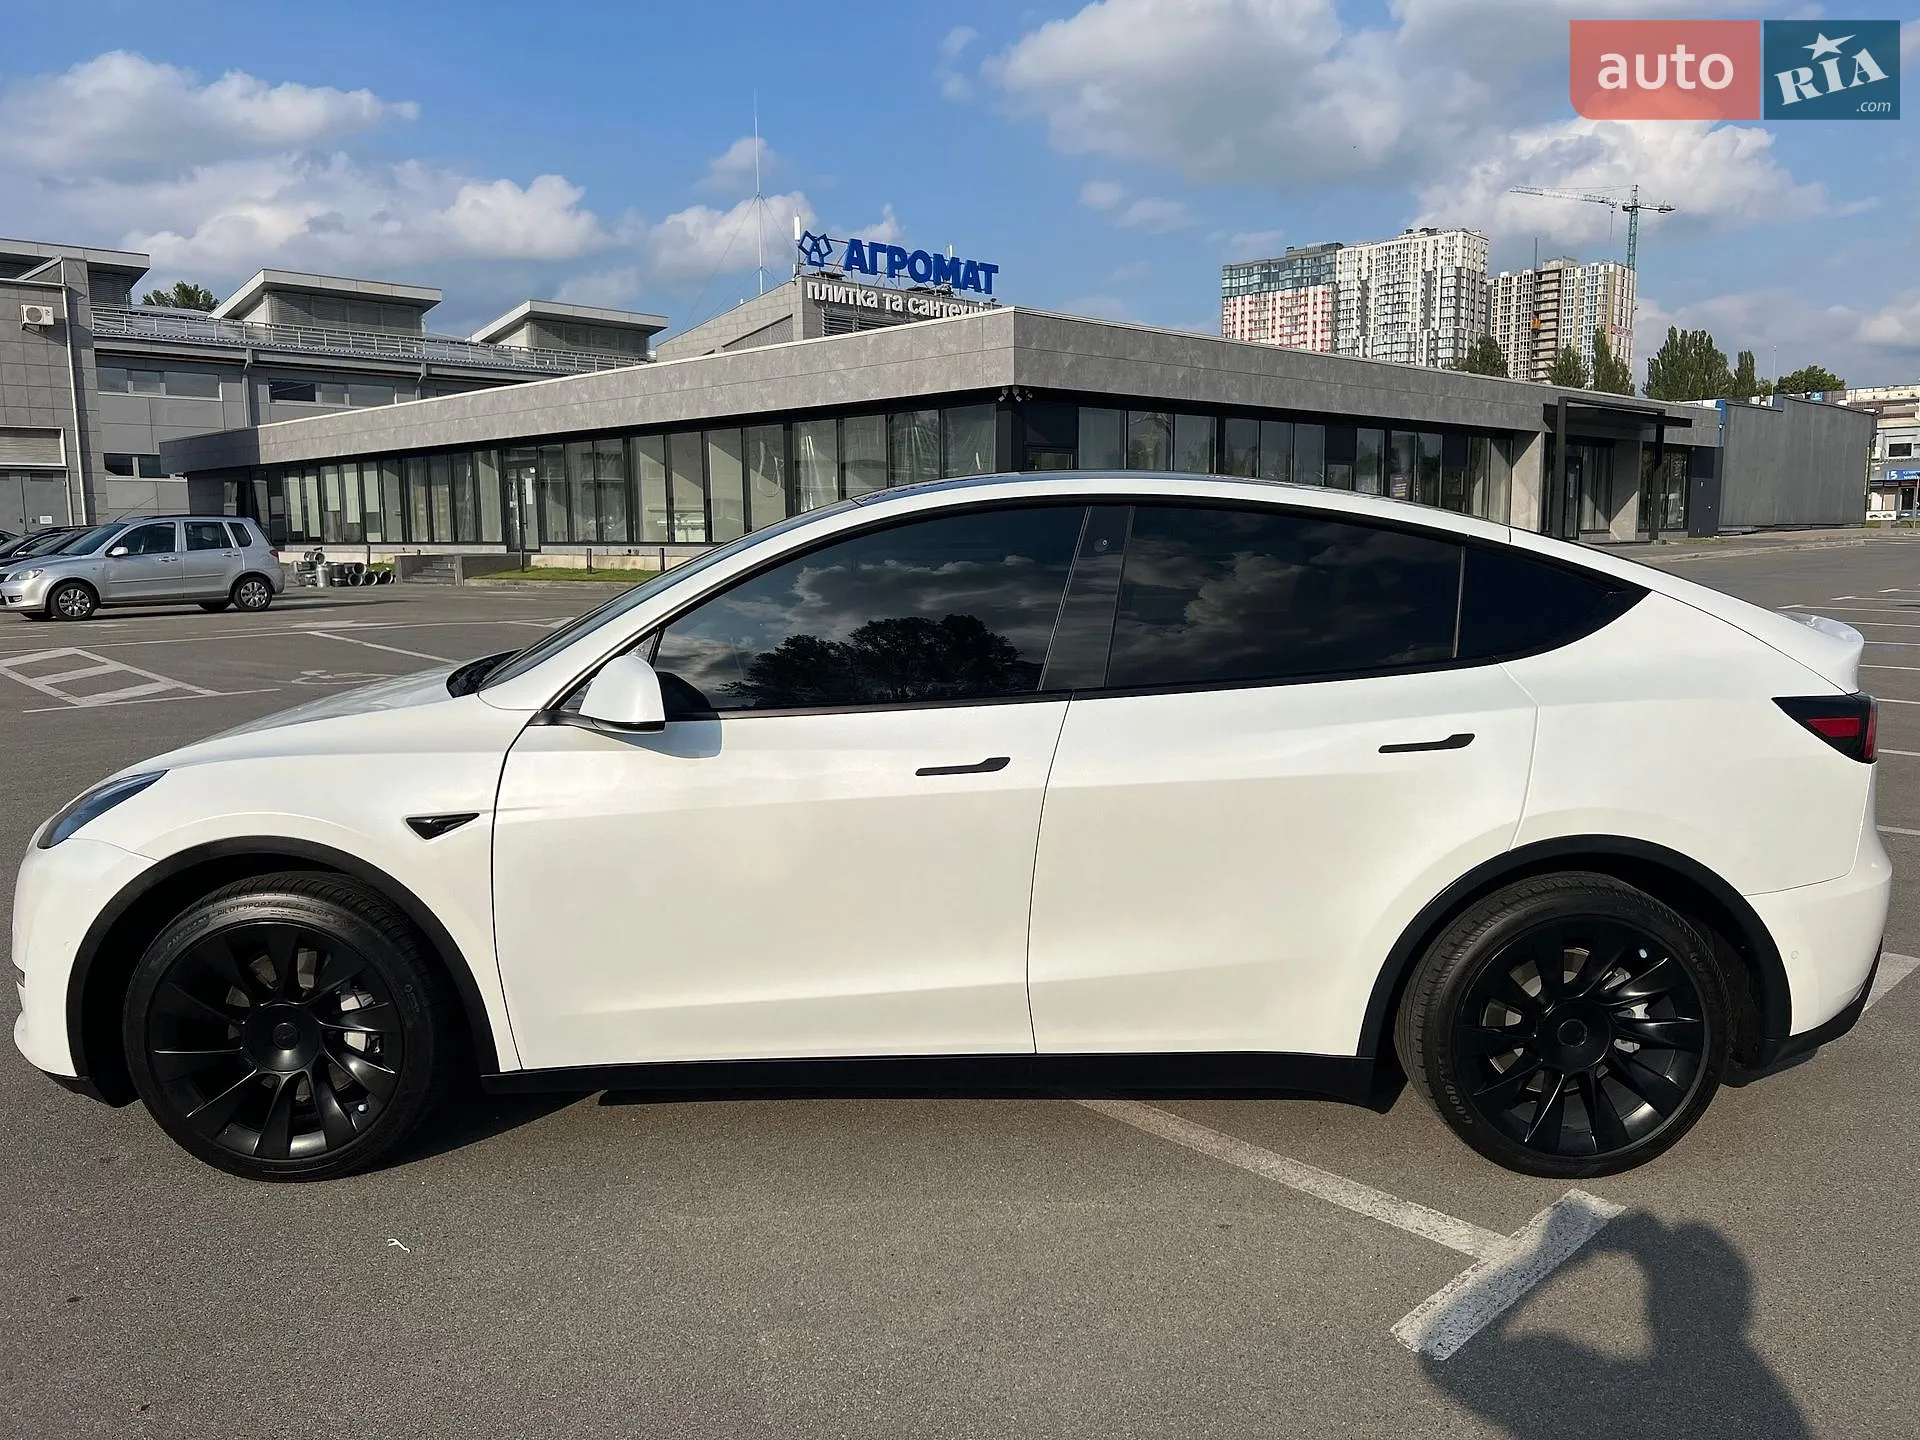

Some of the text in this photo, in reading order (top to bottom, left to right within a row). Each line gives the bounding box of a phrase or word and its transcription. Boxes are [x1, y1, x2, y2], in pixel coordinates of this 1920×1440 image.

[843, 238, 999, 294] АГРОМАТ
[807, 281, 987, 319] плитка та сантех
